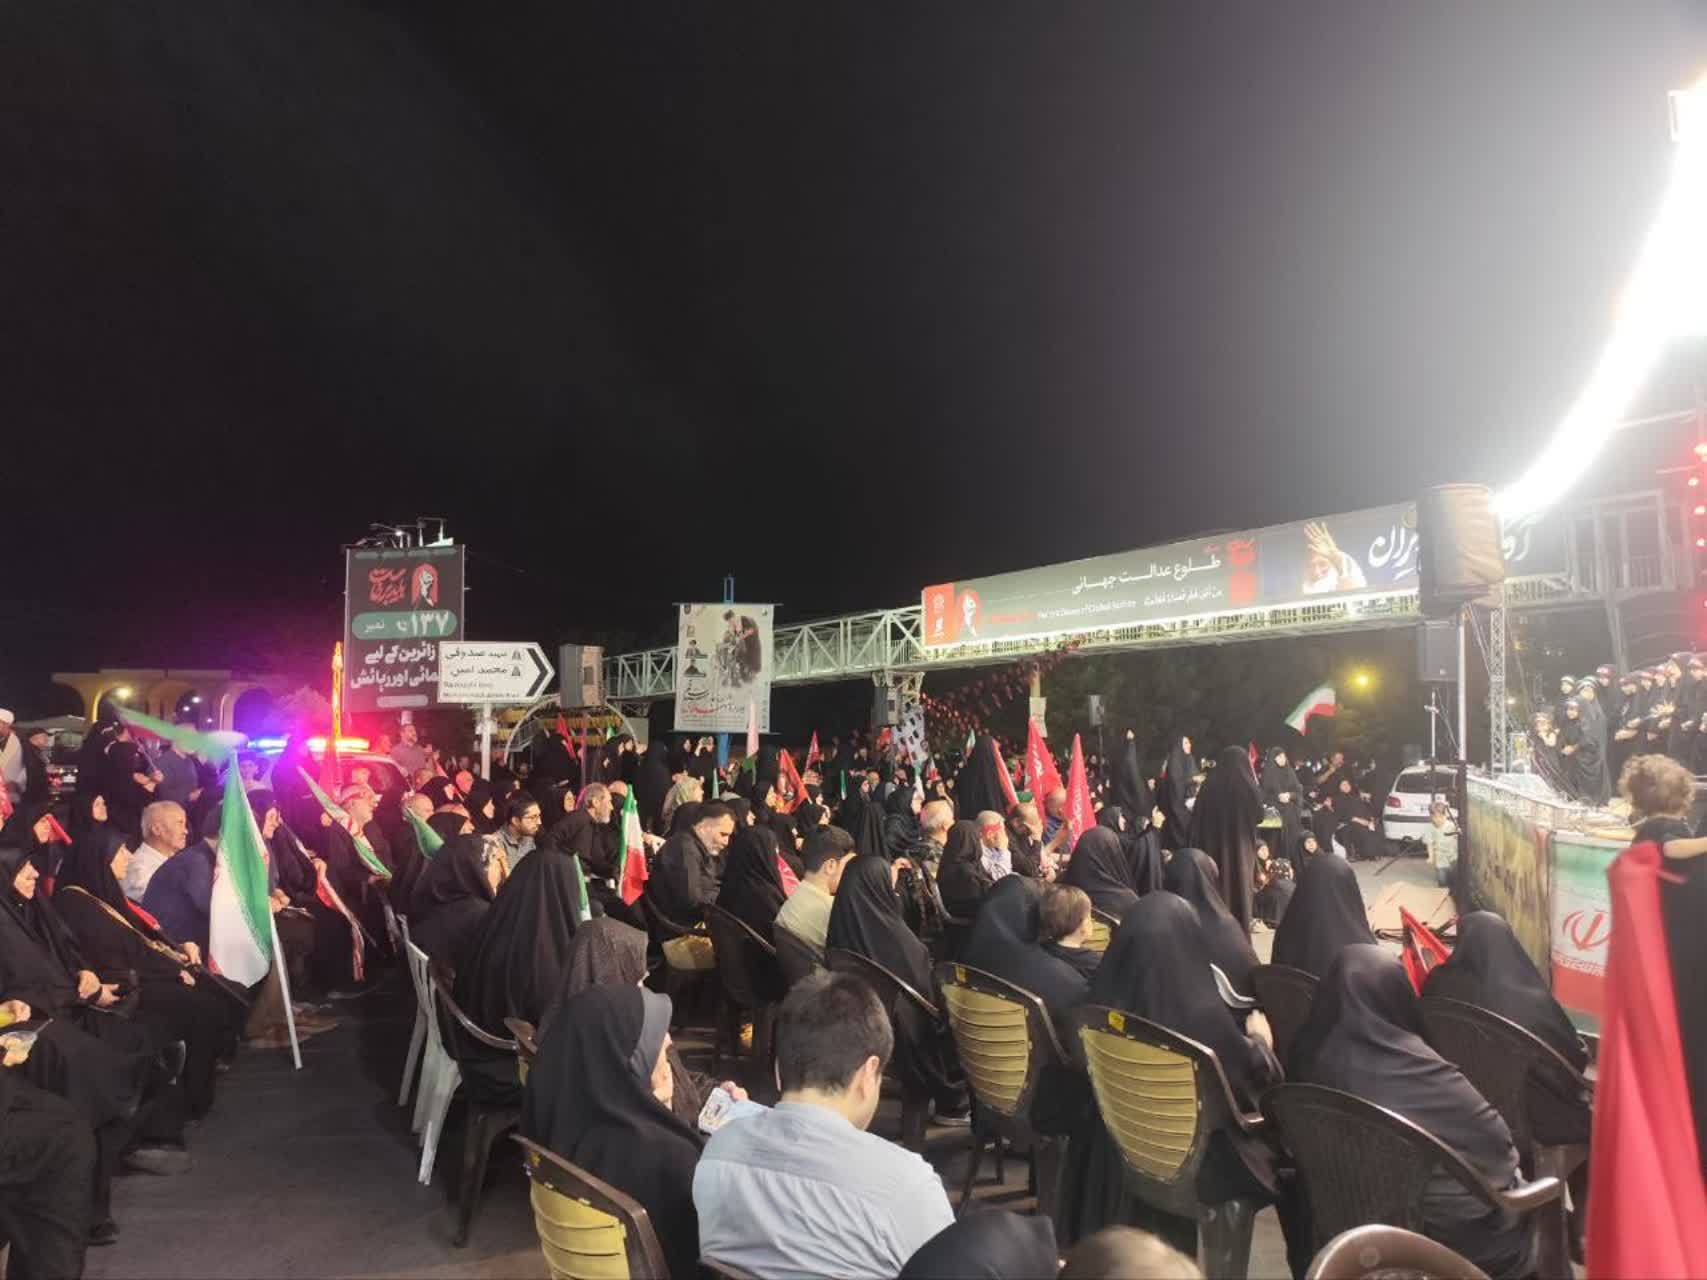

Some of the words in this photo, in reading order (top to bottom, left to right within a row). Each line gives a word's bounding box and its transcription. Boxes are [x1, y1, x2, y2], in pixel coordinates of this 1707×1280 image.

[1120, 562, 1173, 583] عدالت
[1174, 554, 1222, 580] طلوع
[1072, 574, 1119, 596] جهانی
[365, 621, 385, 633] نمبر
[411, 611, 449, 635] ۱۳۷
[400, 642, 436, 662] زائرین
[477, 666, 508, 674] محمد
